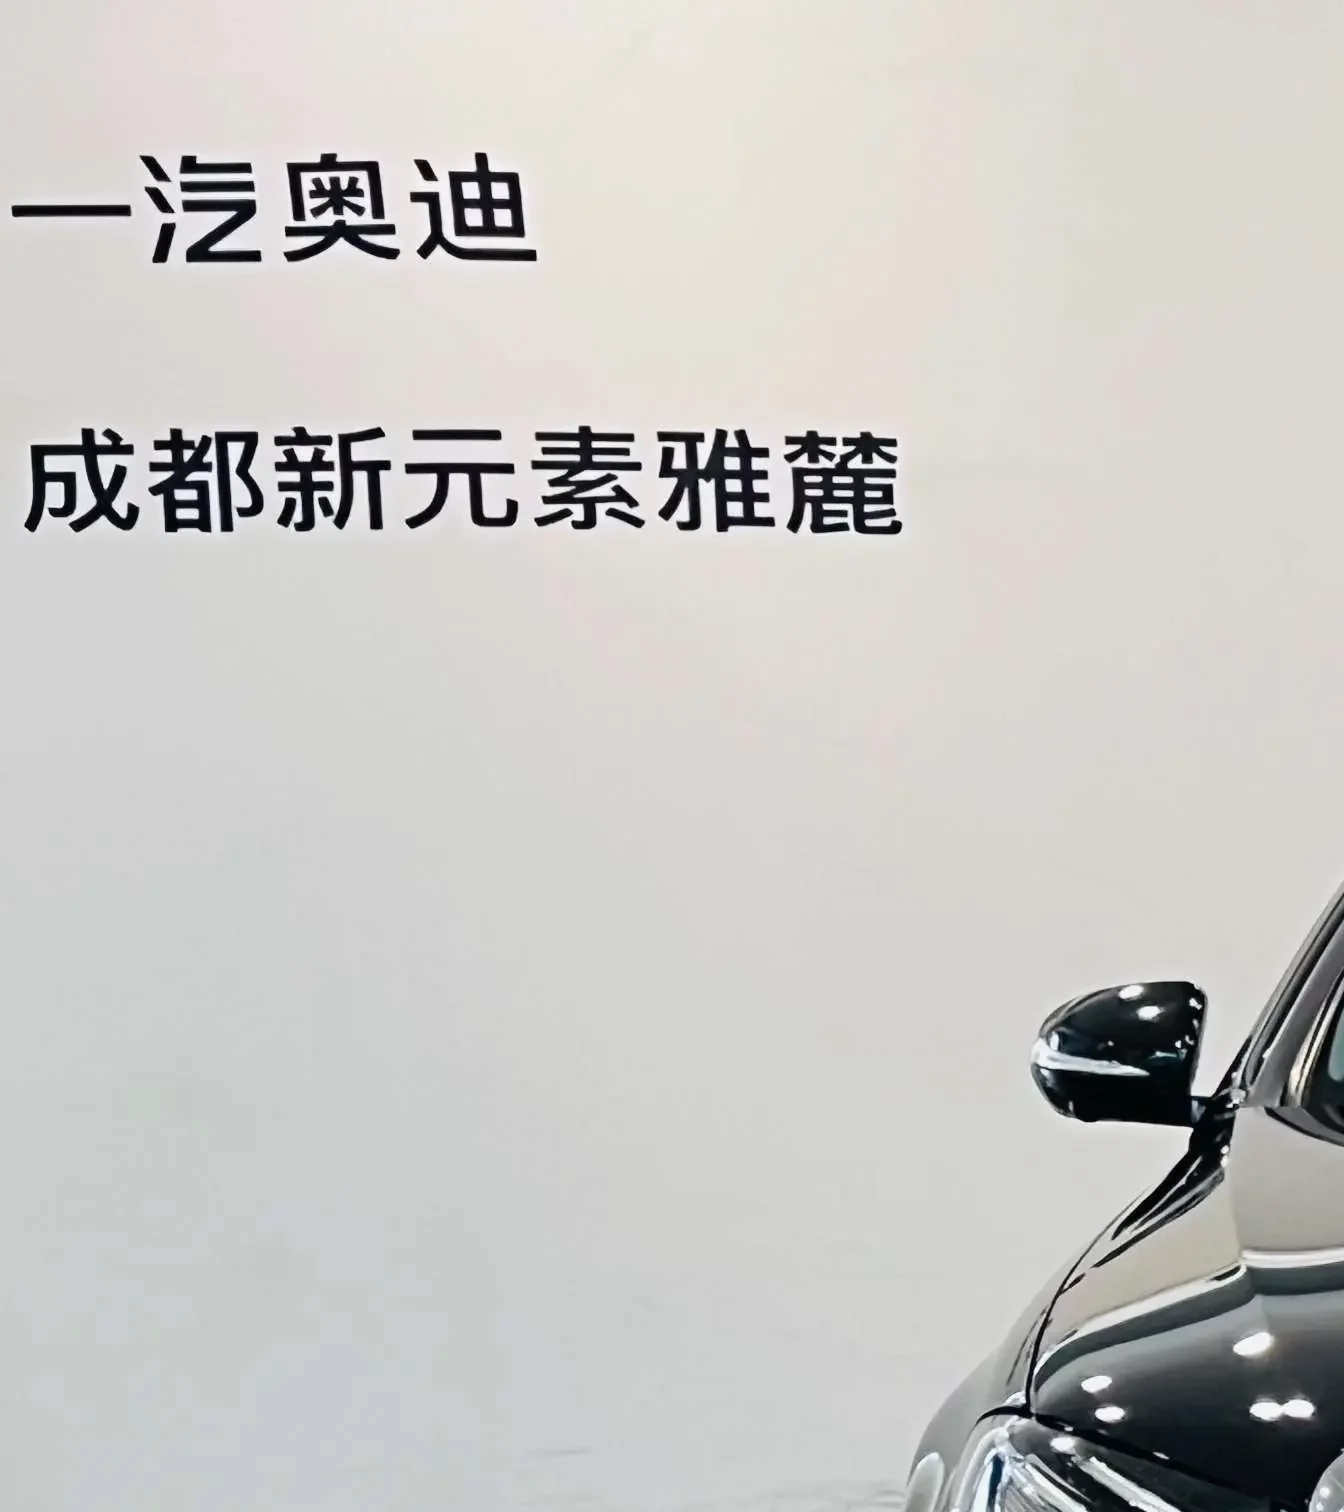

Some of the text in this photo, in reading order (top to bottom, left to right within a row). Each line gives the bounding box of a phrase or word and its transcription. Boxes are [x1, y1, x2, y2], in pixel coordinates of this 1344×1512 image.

[11, 152, 538, 264] 一汽奥迪
[23, 424, 904, 536] 成都新元素雅麓
